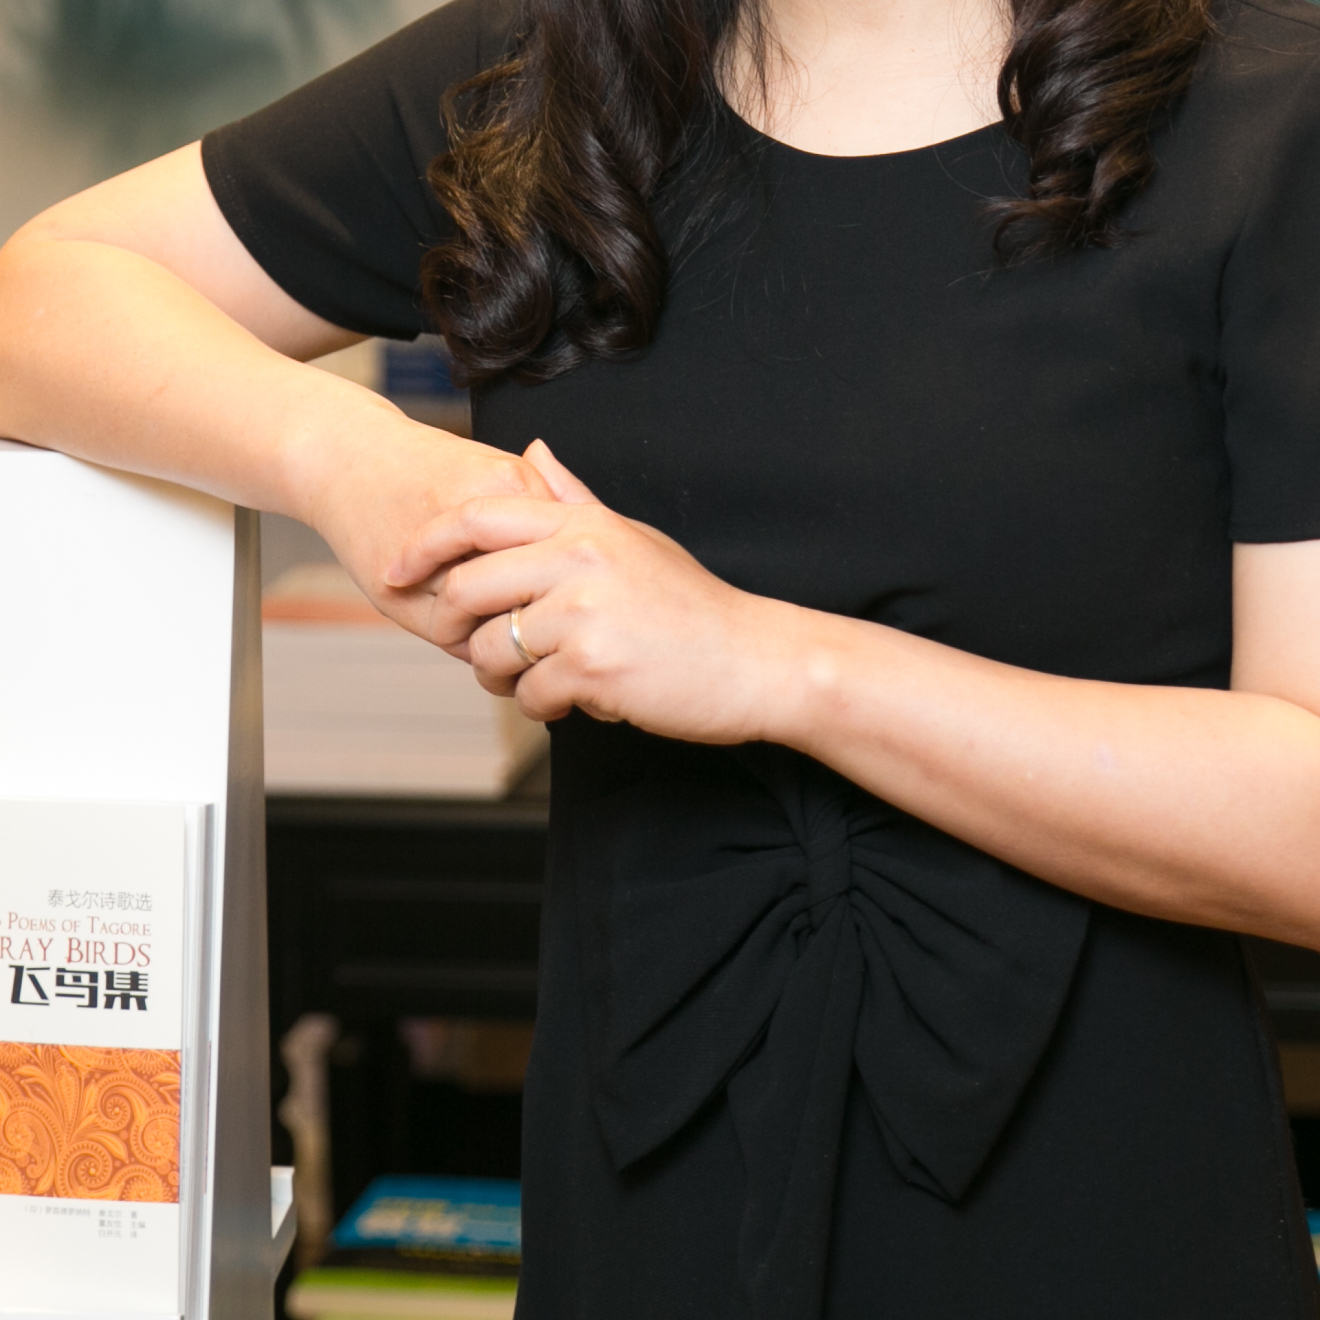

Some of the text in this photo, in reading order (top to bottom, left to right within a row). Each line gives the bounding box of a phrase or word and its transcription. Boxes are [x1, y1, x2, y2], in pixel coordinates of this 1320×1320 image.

[47, 888, 152, 911] 泰戈尔诗歌选
[7, 912, 56, 932] POEMS
[61, 918, 82, 933] OF
[86, 916, 152, 936] TAGORE
[64, 936, 152, 968] BIRDS
[8, 964, 148, 1011] 飞鸟集
